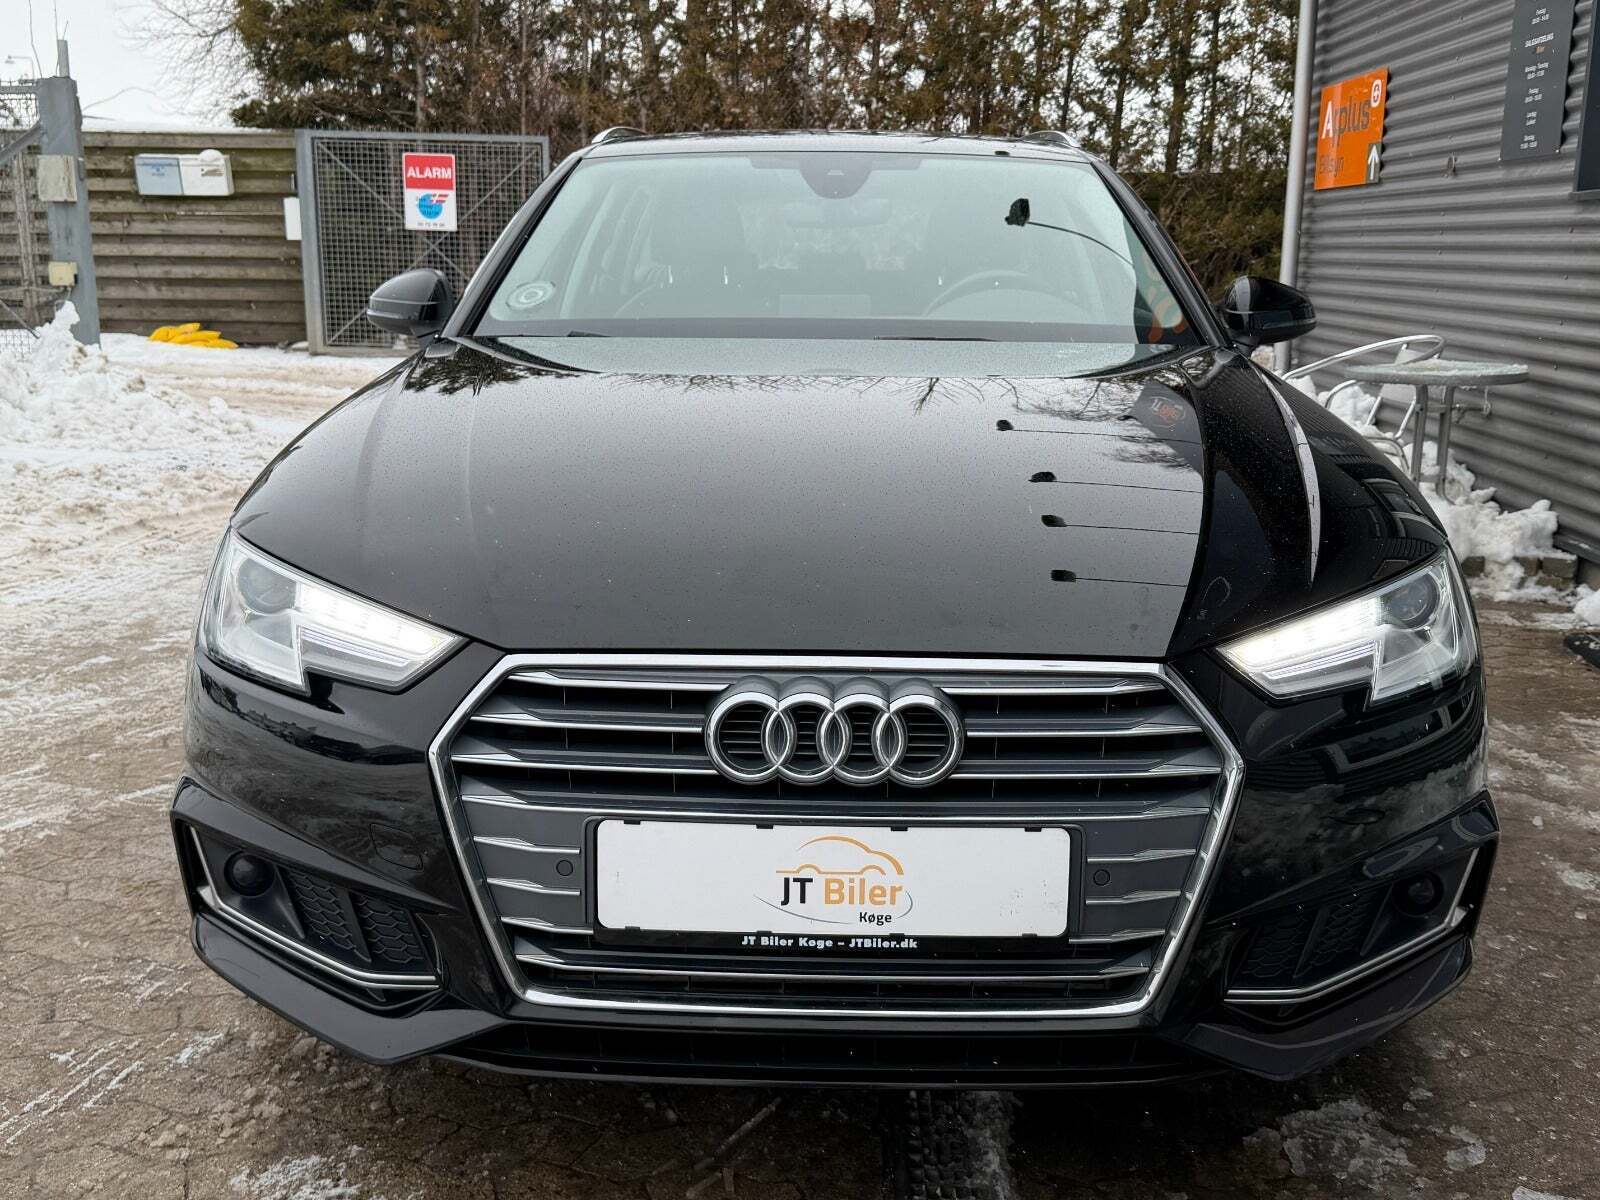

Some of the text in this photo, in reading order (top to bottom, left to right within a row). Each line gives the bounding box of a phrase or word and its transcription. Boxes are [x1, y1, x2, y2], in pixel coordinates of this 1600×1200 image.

[407, 166, 452, 179] ALARM
[780, 877, 903, 906] JT Biler
[859, 911, 892, 926] Køge
[741, 935, 756, 946] JT
[761, 936, 794, 947] Biler
[848, 938, 918, 949] JTBiler.dk
